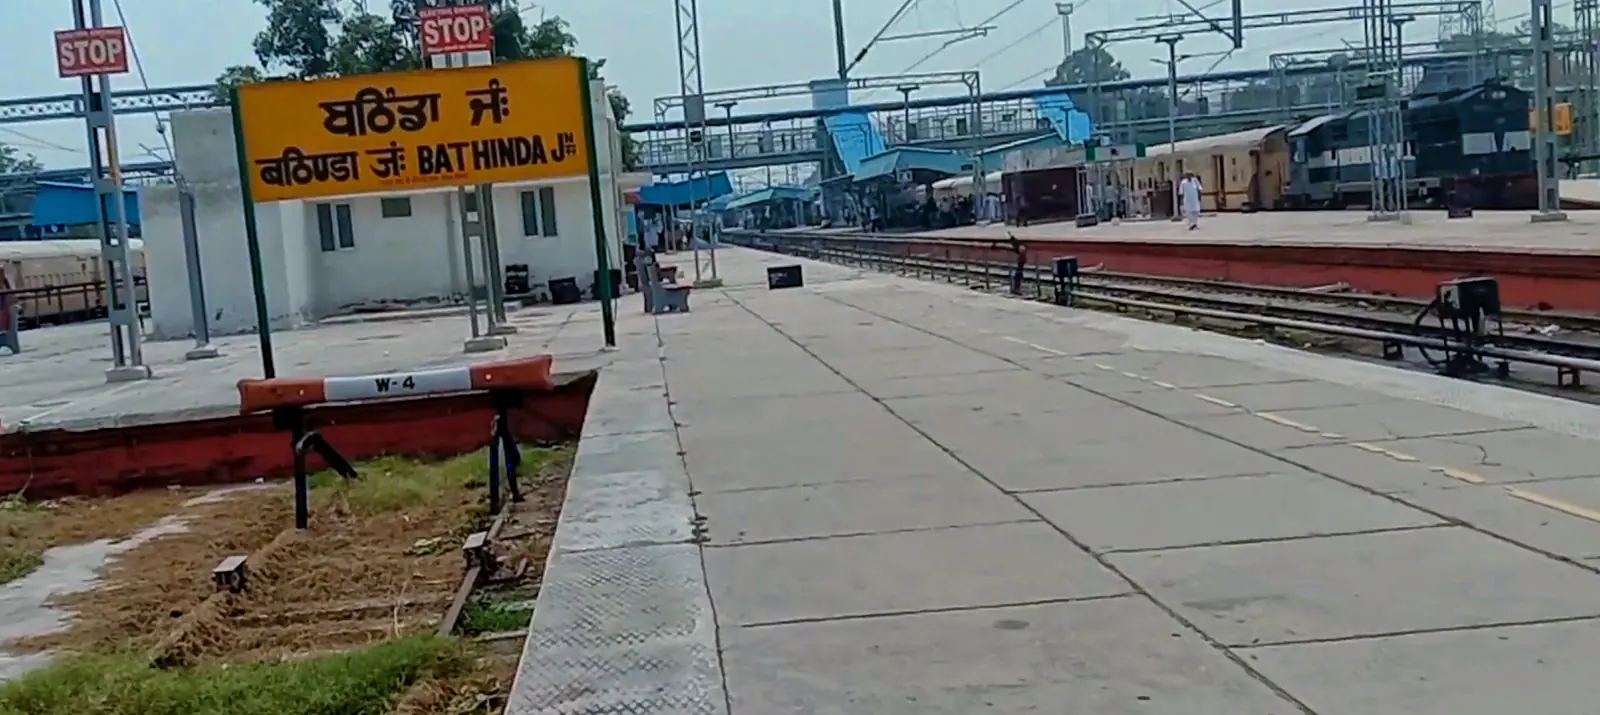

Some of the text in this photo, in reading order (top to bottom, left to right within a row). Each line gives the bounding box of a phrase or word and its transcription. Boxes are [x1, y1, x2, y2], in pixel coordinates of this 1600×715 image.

[423, 15, 485, 45] STOP
[60, 38, 122, 68] STOP
[318, 87, 441, 137] ਬਠਿੰਡਾ
[254, 146, 359, 187] बठिण्डा
[416, 134, 548, 175] BATHINDA
